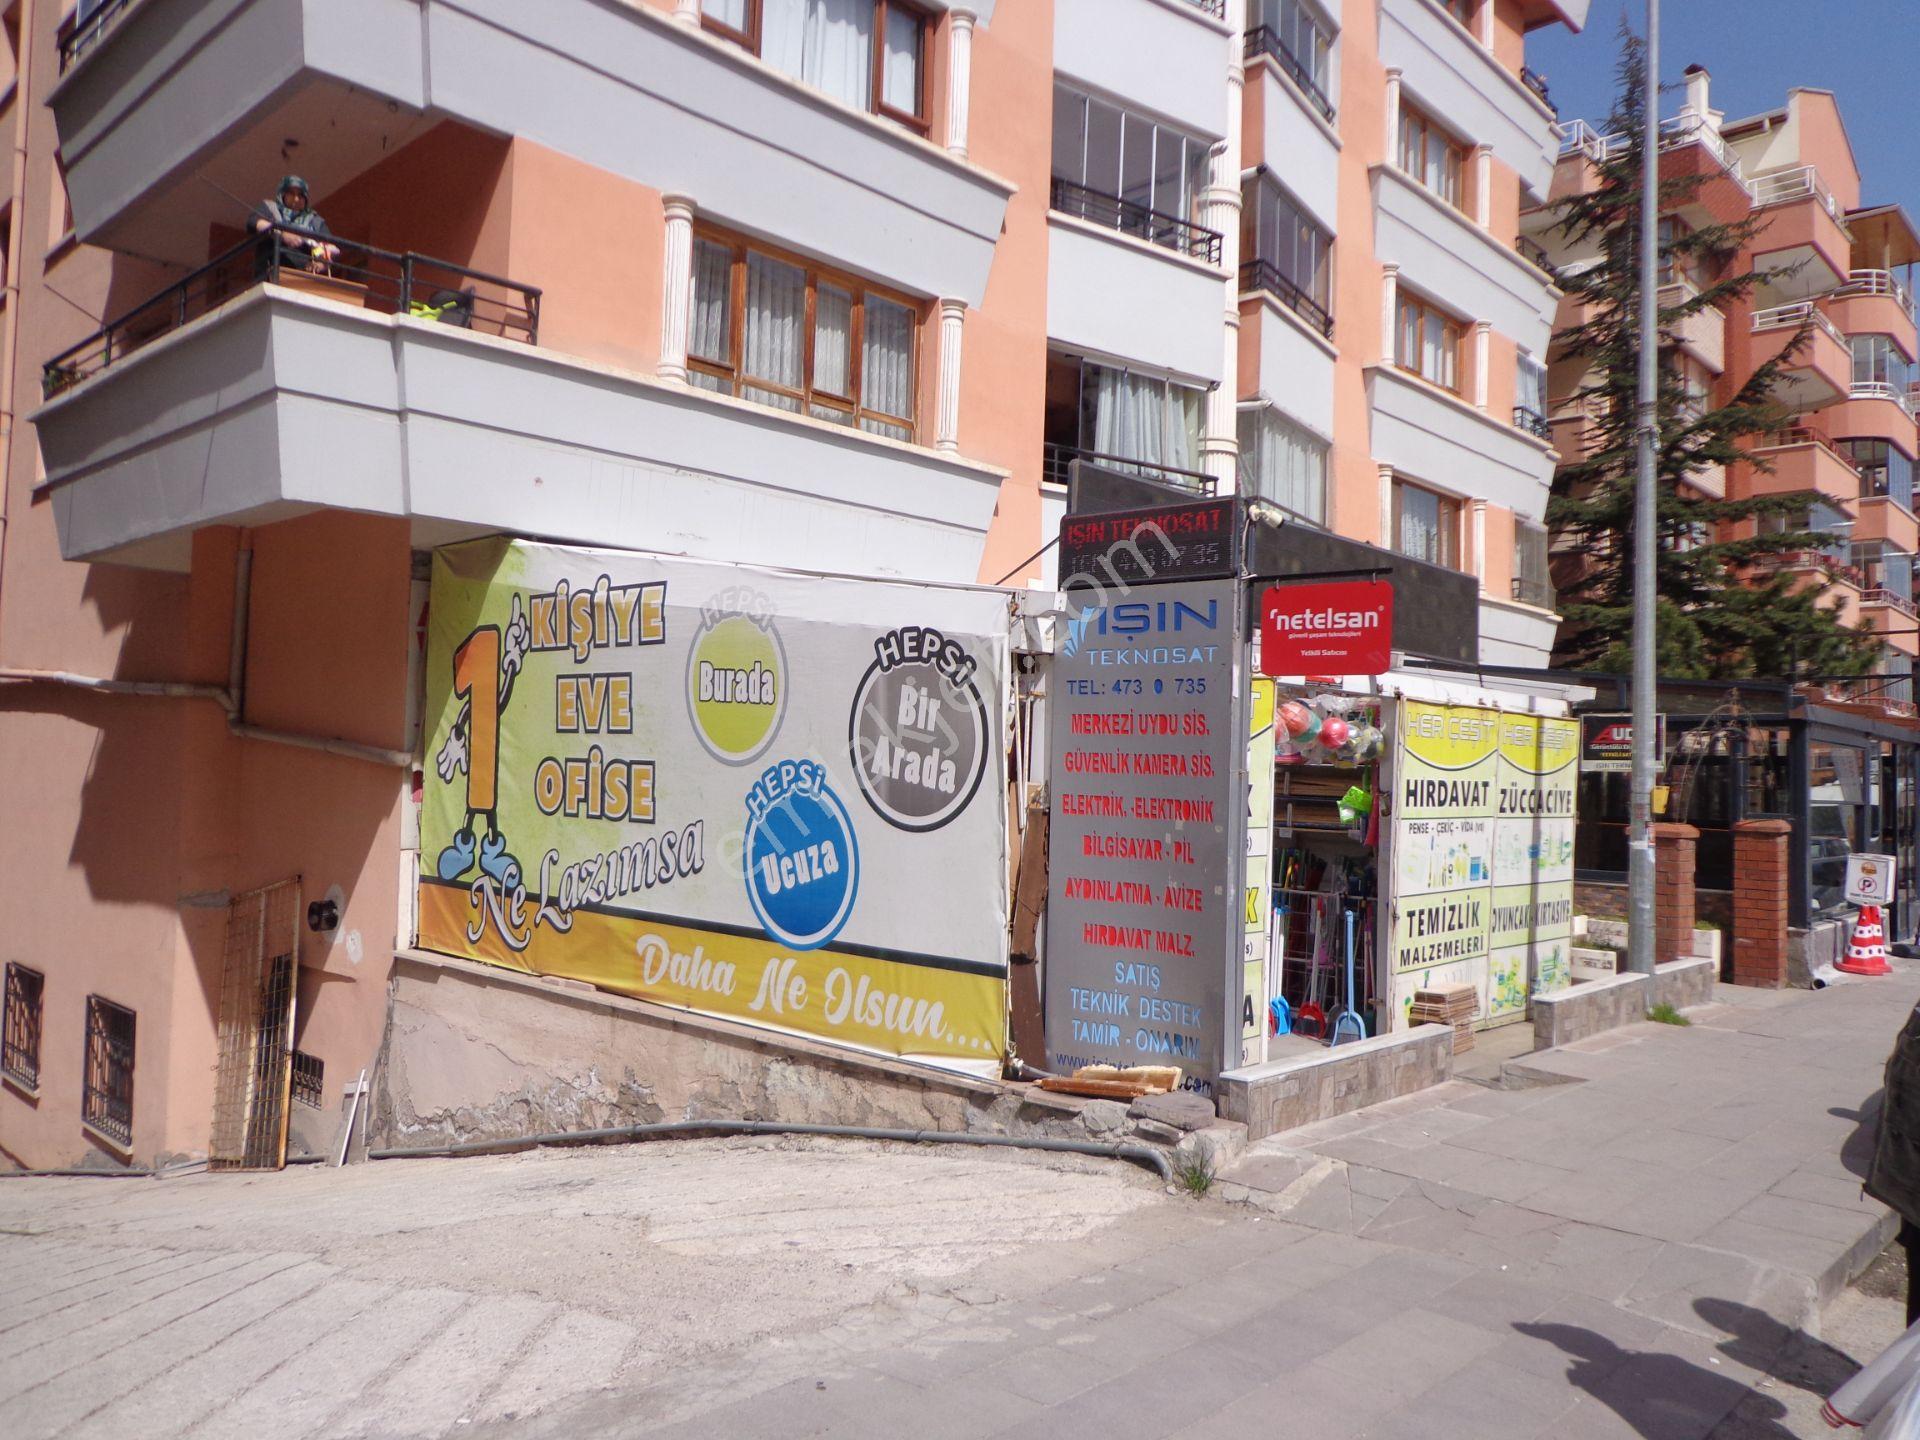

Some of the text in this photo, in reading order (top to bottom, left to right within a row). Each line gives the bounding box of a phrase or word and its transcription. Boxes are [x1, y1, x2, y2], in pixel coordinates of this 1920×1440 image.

[529, 574, 667, 663] KİŞİYE
[1098, 600, 1217, 642] IŞIN
[1270, 607, 1379, 631] netelsan
[1086, 646, 1218, 665] TEKNOSAT
[699, 660, 776, 705] Burada
[1067, 680, 1105, 695] TEL:
[1112, 679, 1143, 695] 473
[1175, 678, 1206, 695] 735
[556, 672, 633, 733] EVE
[898, 680, 941, 729] Bir
[1071, 708, 1210, 736] MERKEZİ UYDU SİS.
[1406, 712, 1444, 738] HER
[871, 748, 956, 794] Arada
[1064, 748, 1215, 777] GÜVENLİK KAMERA SİS.
[535, 745, 656, 823] OFİSE
[1406, 779, 1489, 807] HIRDAVAT
[1500, 782, 1572, 813] ZÜCCACİYE
[1409, 822, 1429, 834] PENSE
[1083, 830, 1162, 861] BİLGİSAYAR
[1174, 839, 1195, 864] PİL
[762, 837, 839, 895] Ucuza
[467, 820, 705, 951] Ne Lazımsa
[1065, 877, 1152, 905] AYDINLATMA
[1164, 883, 1203, 912] AVİZE
[1407, 896, 1480, 938] TEMİZLİK
[1492, 904, 1530, 933] OYUNCAK
[1083, 922, 1195, 957] HIRDAVAT MALZ.
[1400, 931, 1484, 967] MALZEMELERİ
[637, 934, 736, 997] Daha
[749, 958, 809, 1013] Ne
[1115, 961, 1161, 993] SATIŞ
[1070, 987, 1201, 1028] TEKNİK DESTEK
[1071, 1018, 1121, 1047] TAMİR
